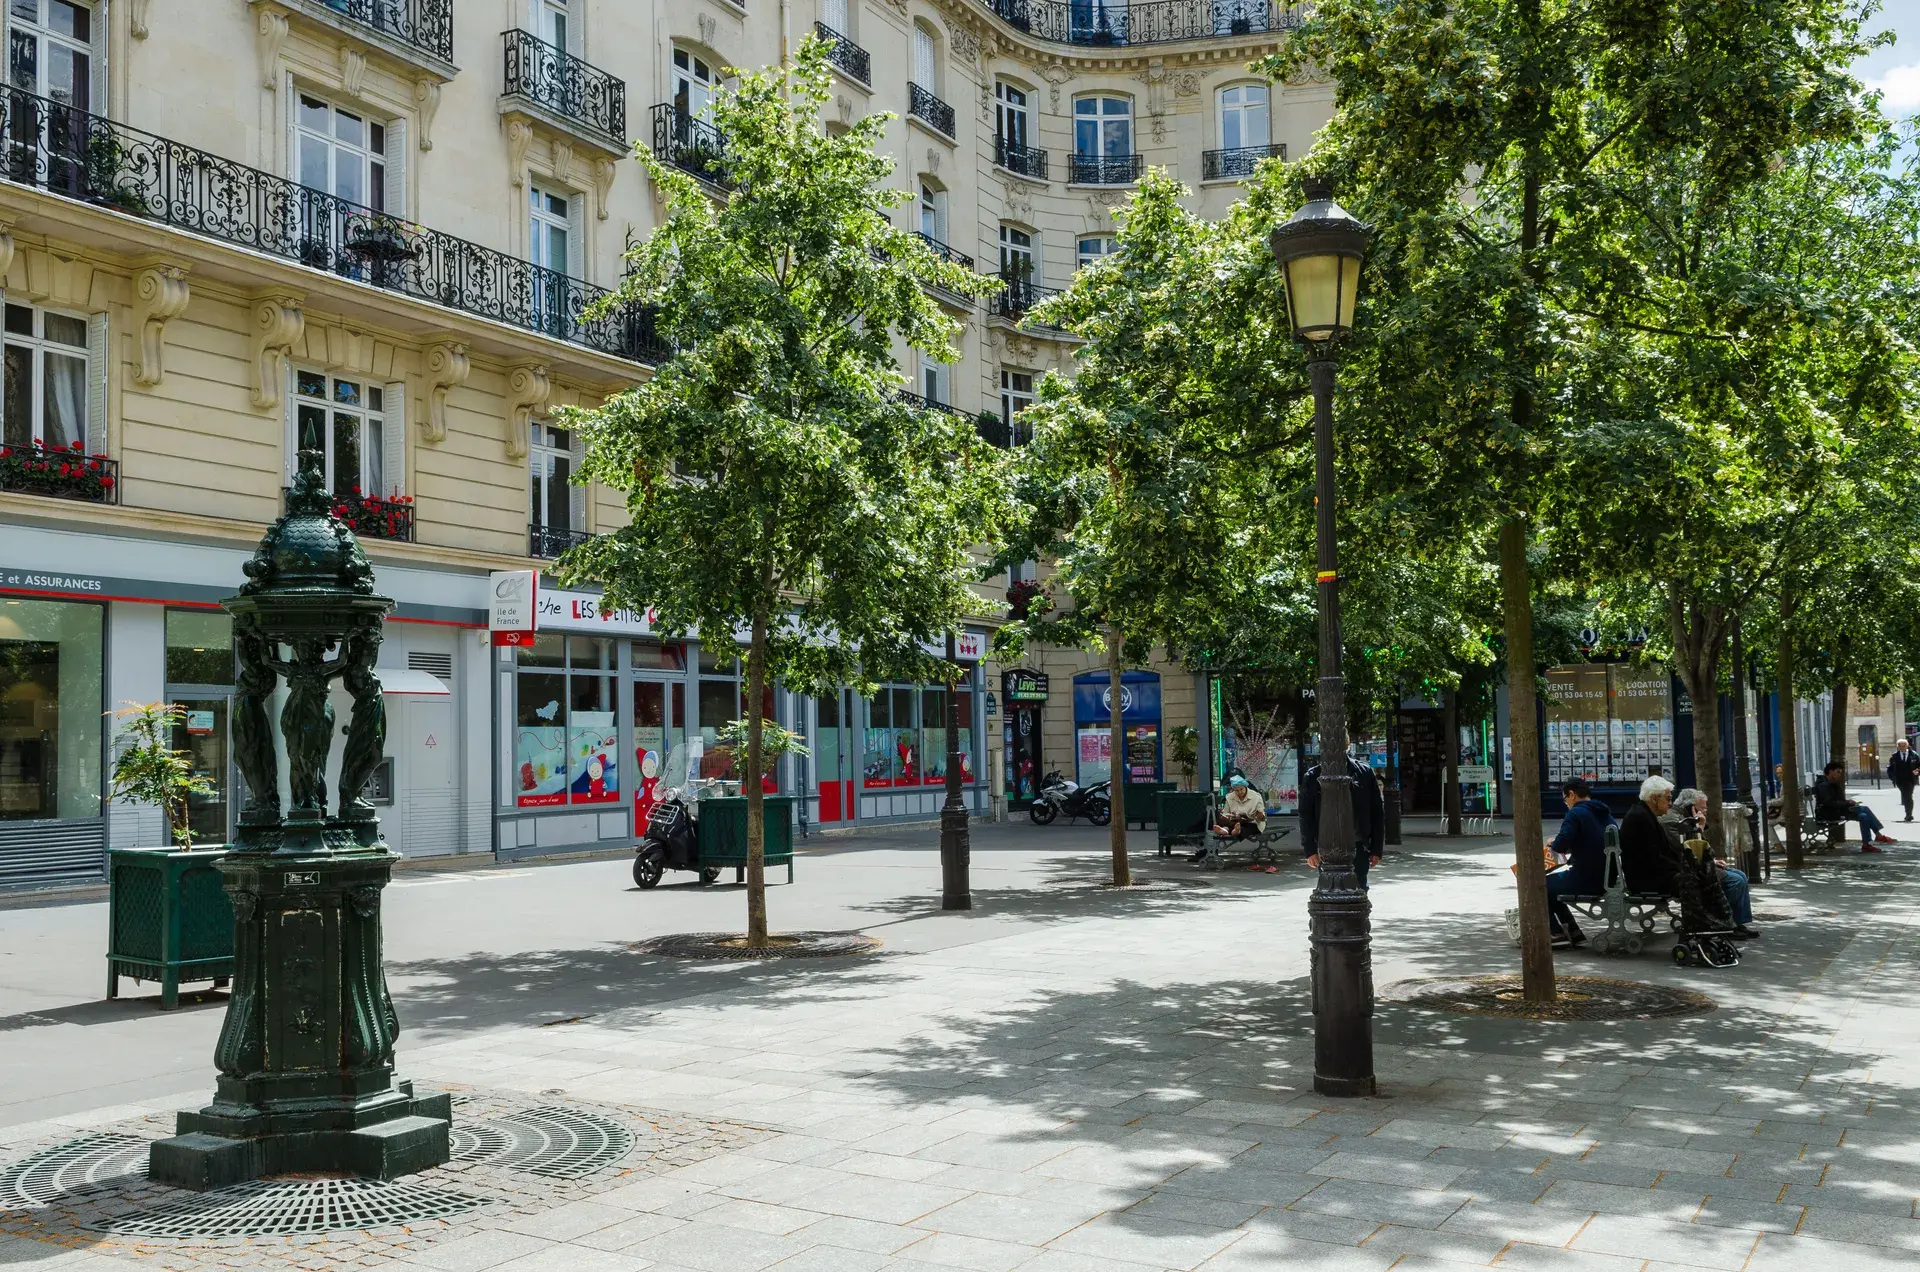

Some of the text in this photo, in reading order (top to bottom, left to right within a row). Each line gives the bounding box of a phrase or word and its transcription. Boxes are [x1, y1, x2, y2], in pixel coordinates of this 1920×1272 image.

[8, 575, 20, 584] et
[25, 575, 101, 590] ASSURANCES
[508, 608, 517, 616] de
[572, 600, 594, 619] LES
[497, 617, 520, 625] France
[1547, 683, 1575, 691] VENTE
[1626, 680, 1668, 689] LOCATION
